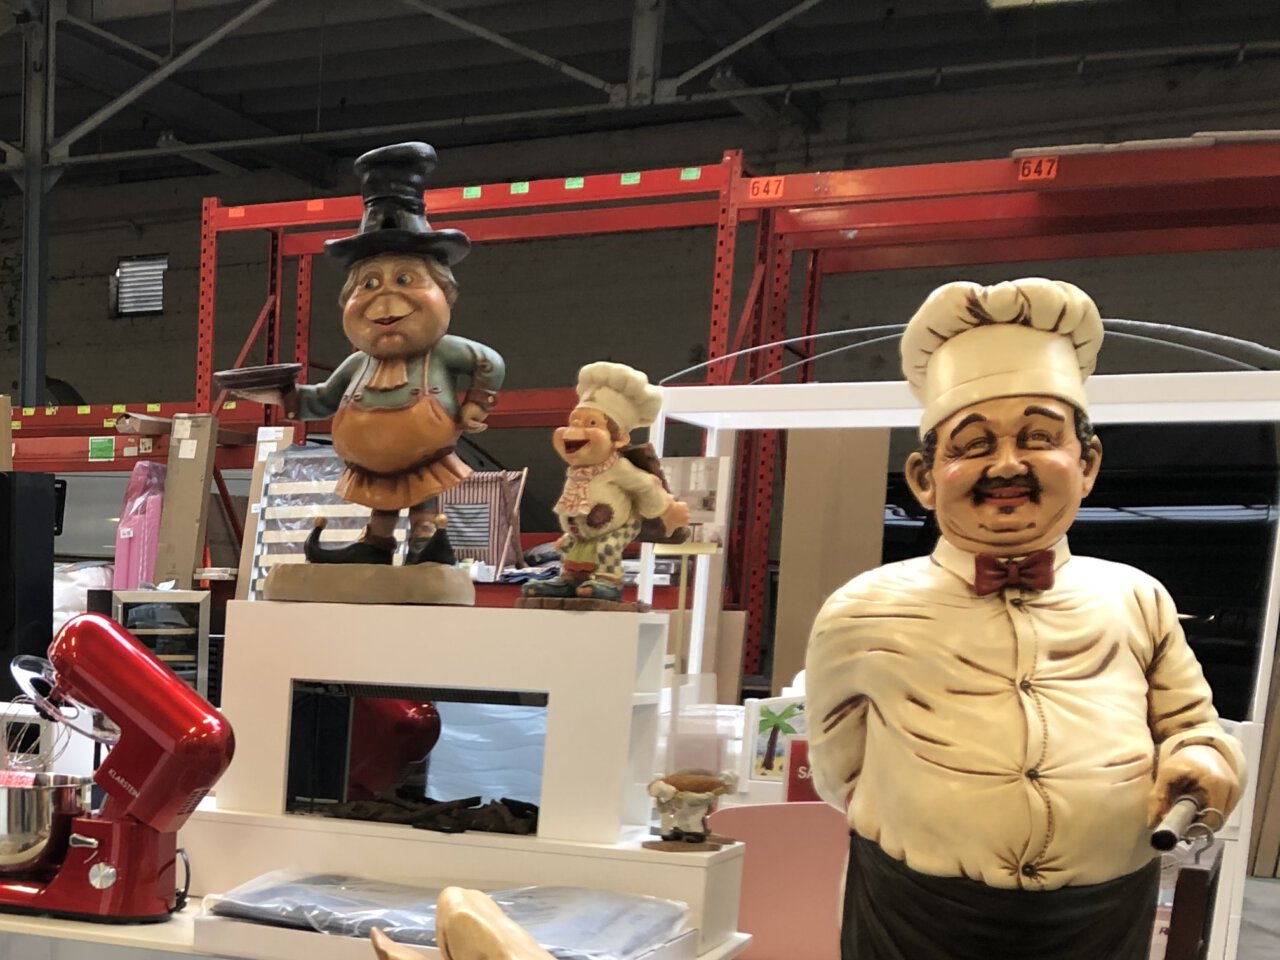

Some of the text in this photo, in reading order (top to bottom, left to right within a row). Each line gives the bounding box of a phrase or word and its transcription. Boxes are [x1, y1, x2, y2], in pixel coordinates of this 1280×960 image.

[1021, 158, 1057, 178] 647
[751, 179, 783, 198] 647
[108, 768, 140, 798] KLARSTEIN
